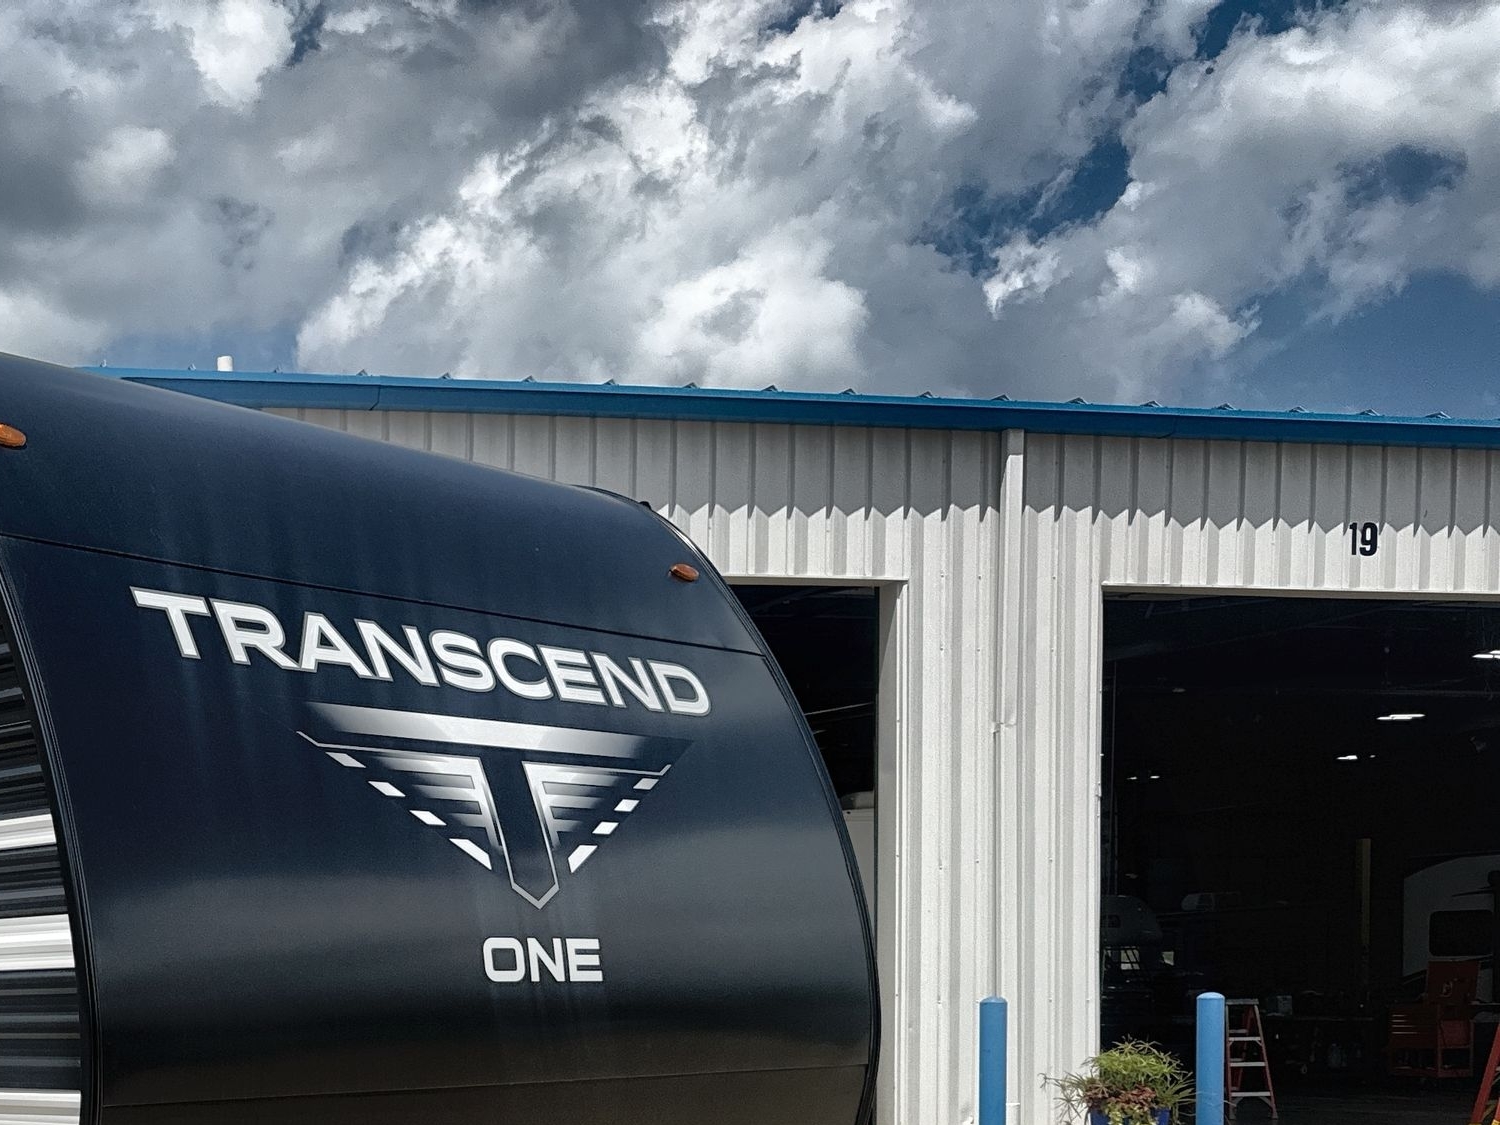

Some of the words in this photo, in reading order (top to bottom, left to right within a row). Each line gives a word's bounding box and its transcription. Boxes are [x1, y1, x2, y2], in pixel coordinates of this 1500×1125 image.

[1349, 522, 1378, 556] 19
[130, 586, 710, 717] TRANSCEND
[482, 937, 603, 982] ONE
